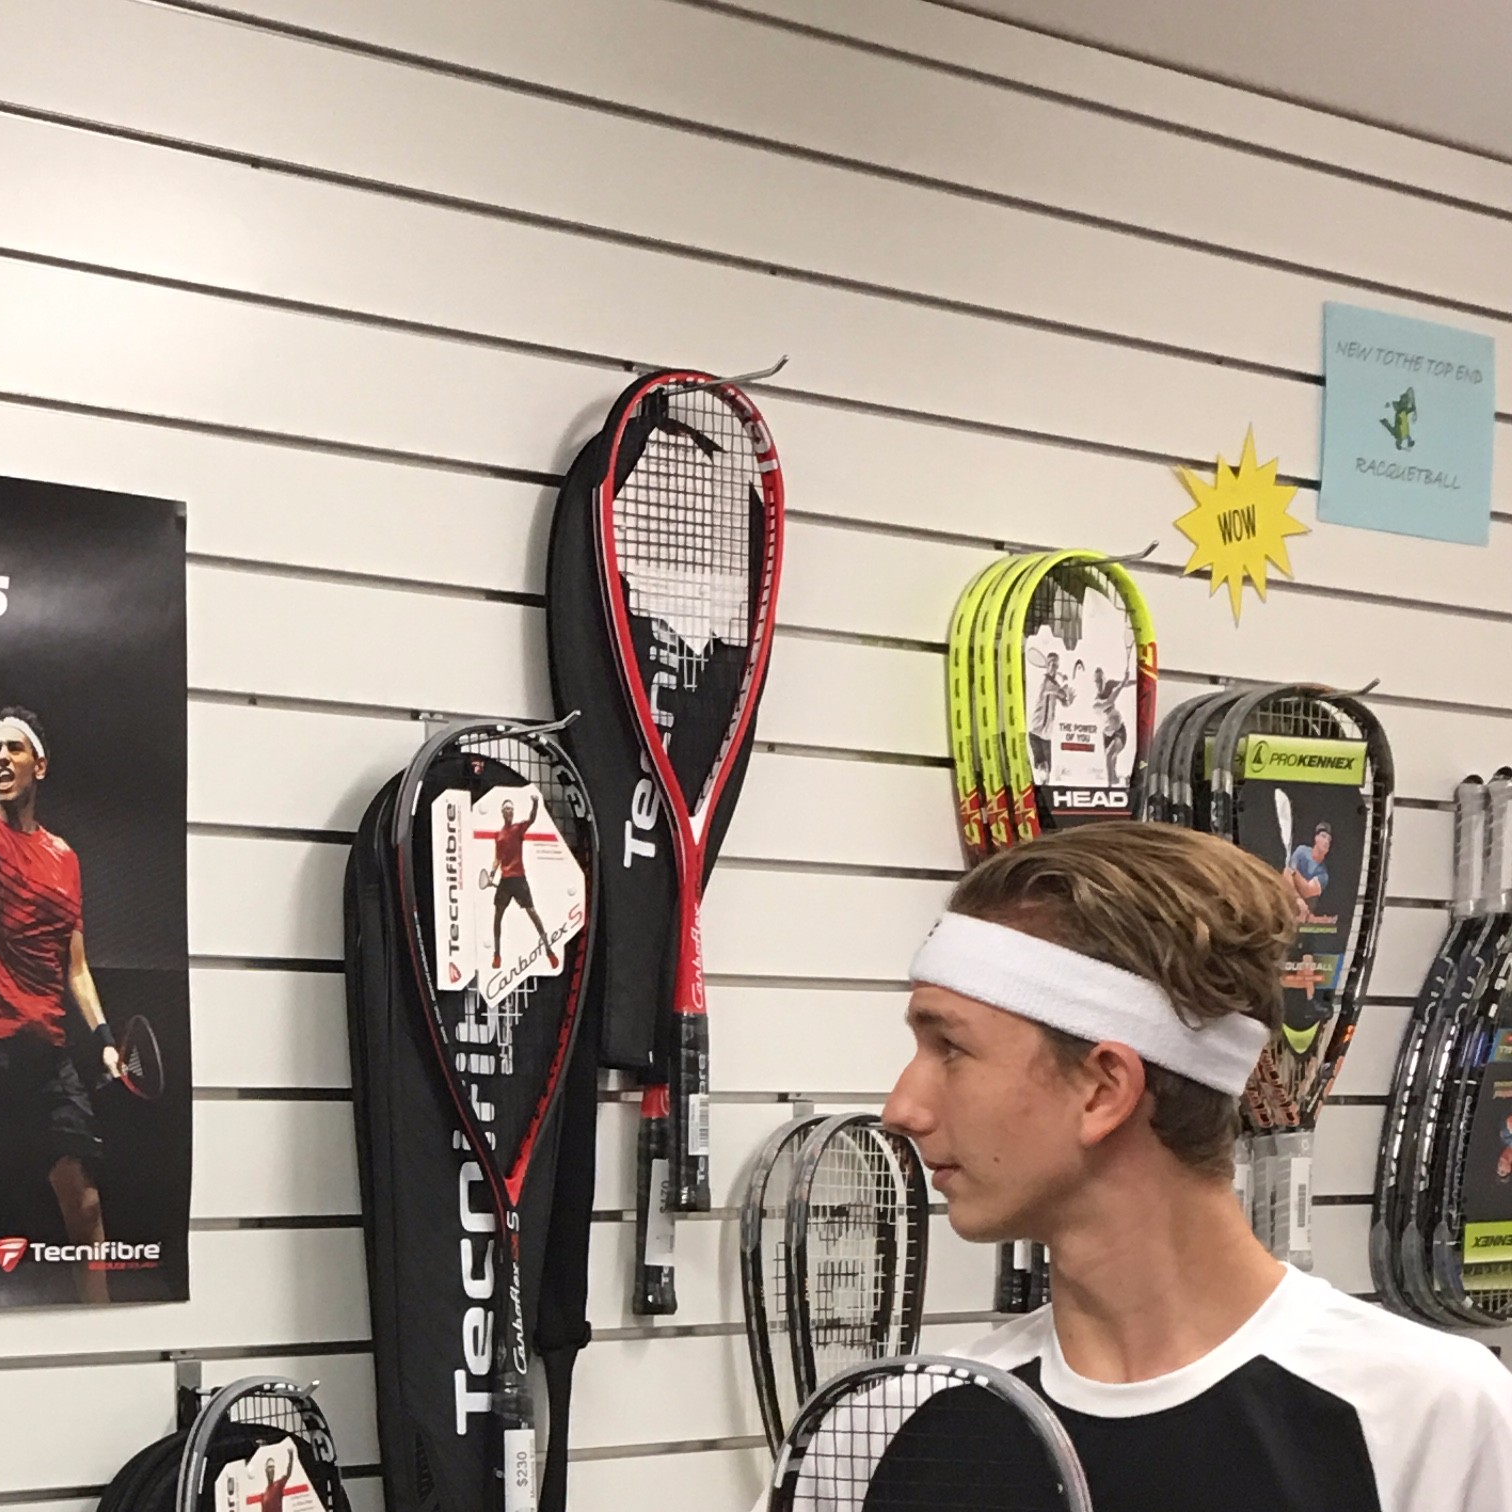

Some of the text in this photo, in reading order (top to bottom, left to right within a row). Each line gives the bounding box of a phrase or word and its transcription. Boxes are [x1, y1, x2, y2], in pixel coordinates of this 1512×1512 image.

[1337, 340, 1372, 362] NEW
[1427, 359, 1453, 378] TOP
[1456, 365, 1483, 385] END
[1355, 457, 1461, 490] RACQUETBALL
[1217, 504, 1257, 546] WOW
[1269, 751, 1356, 772] PROKENNEX
[1052, 791, 1129, 809] HEAD
[447, 803, 460, 958] Tecnifibre
[485, 923, 568, 1000] Carboflex
[30, 1241, 160, 1262] Tecnifibre
[510, 1262, 528, 1375] Carboflex
[516, 1451, 529, 1488] $230
